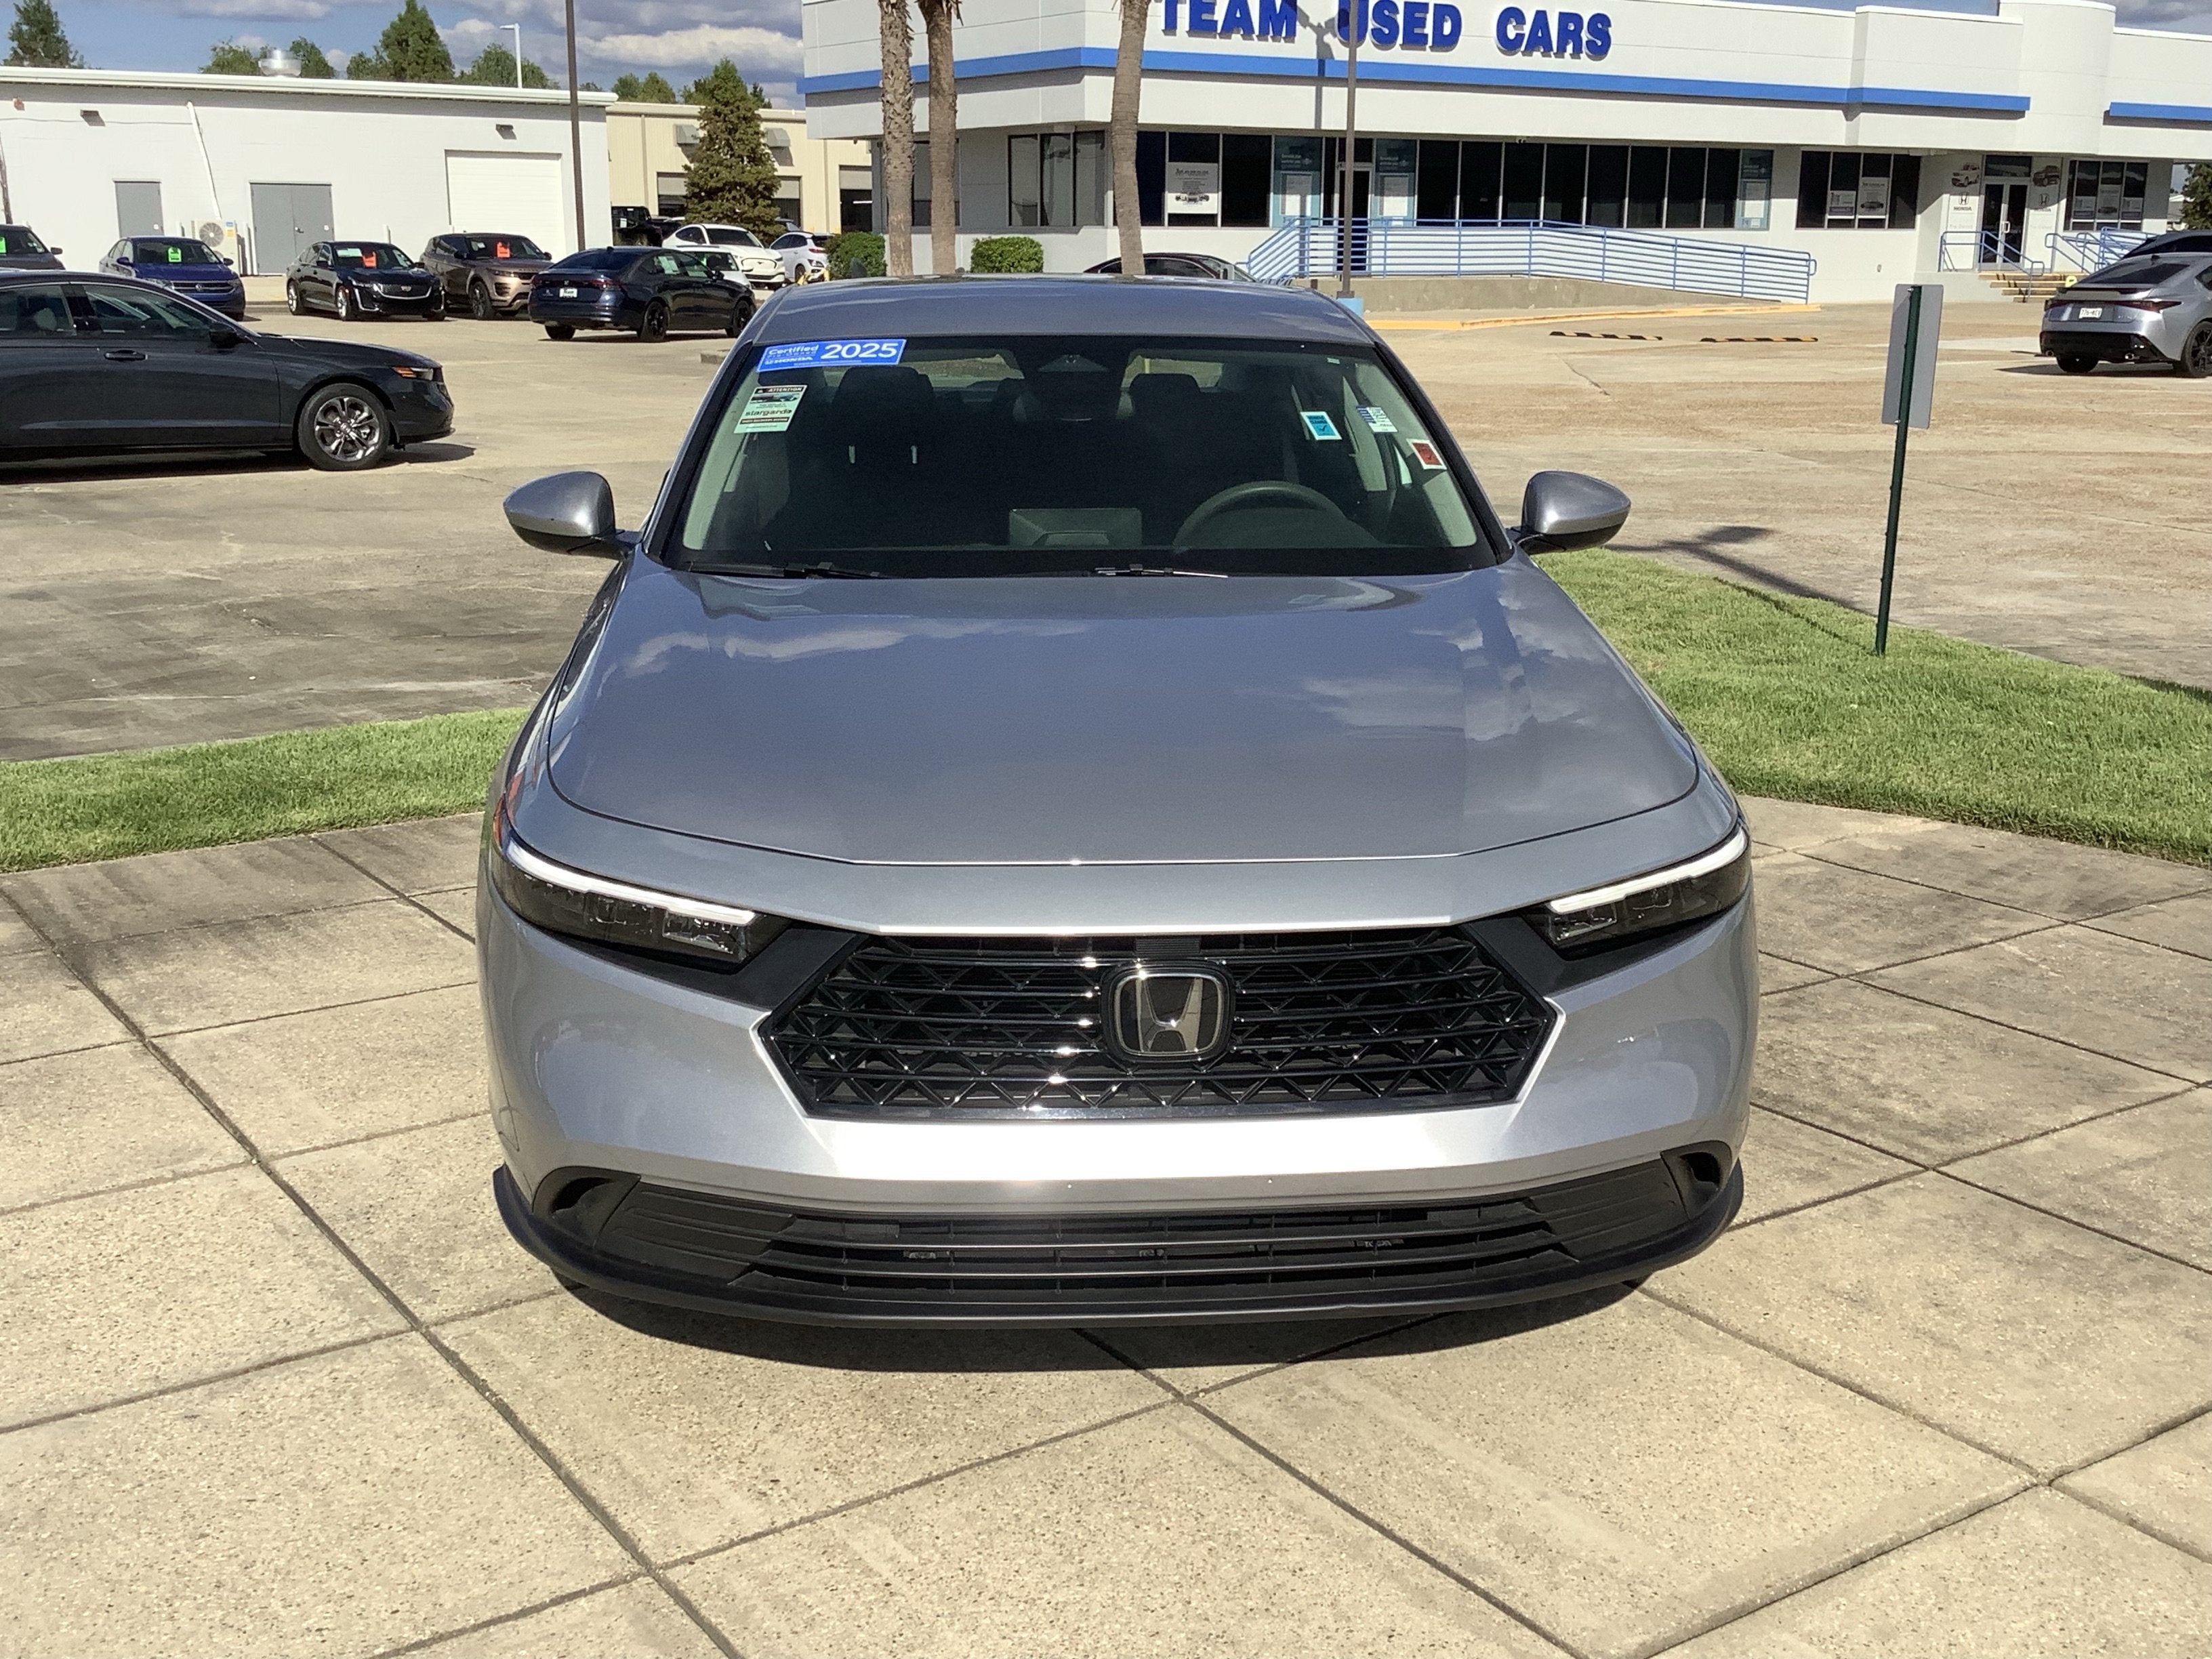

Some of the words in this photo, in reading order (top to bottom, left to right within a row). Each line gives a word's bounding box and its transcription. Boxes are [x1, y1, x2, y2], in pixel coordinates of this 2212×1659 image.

[1156, 0, 1298, 38] TEAM
[1336, 0, 1462, 47] USED
[1496, 6, 1612, 57] CARS
[769, 344, 819, 355] Certified
[820, 342, 899, 359] 2025
